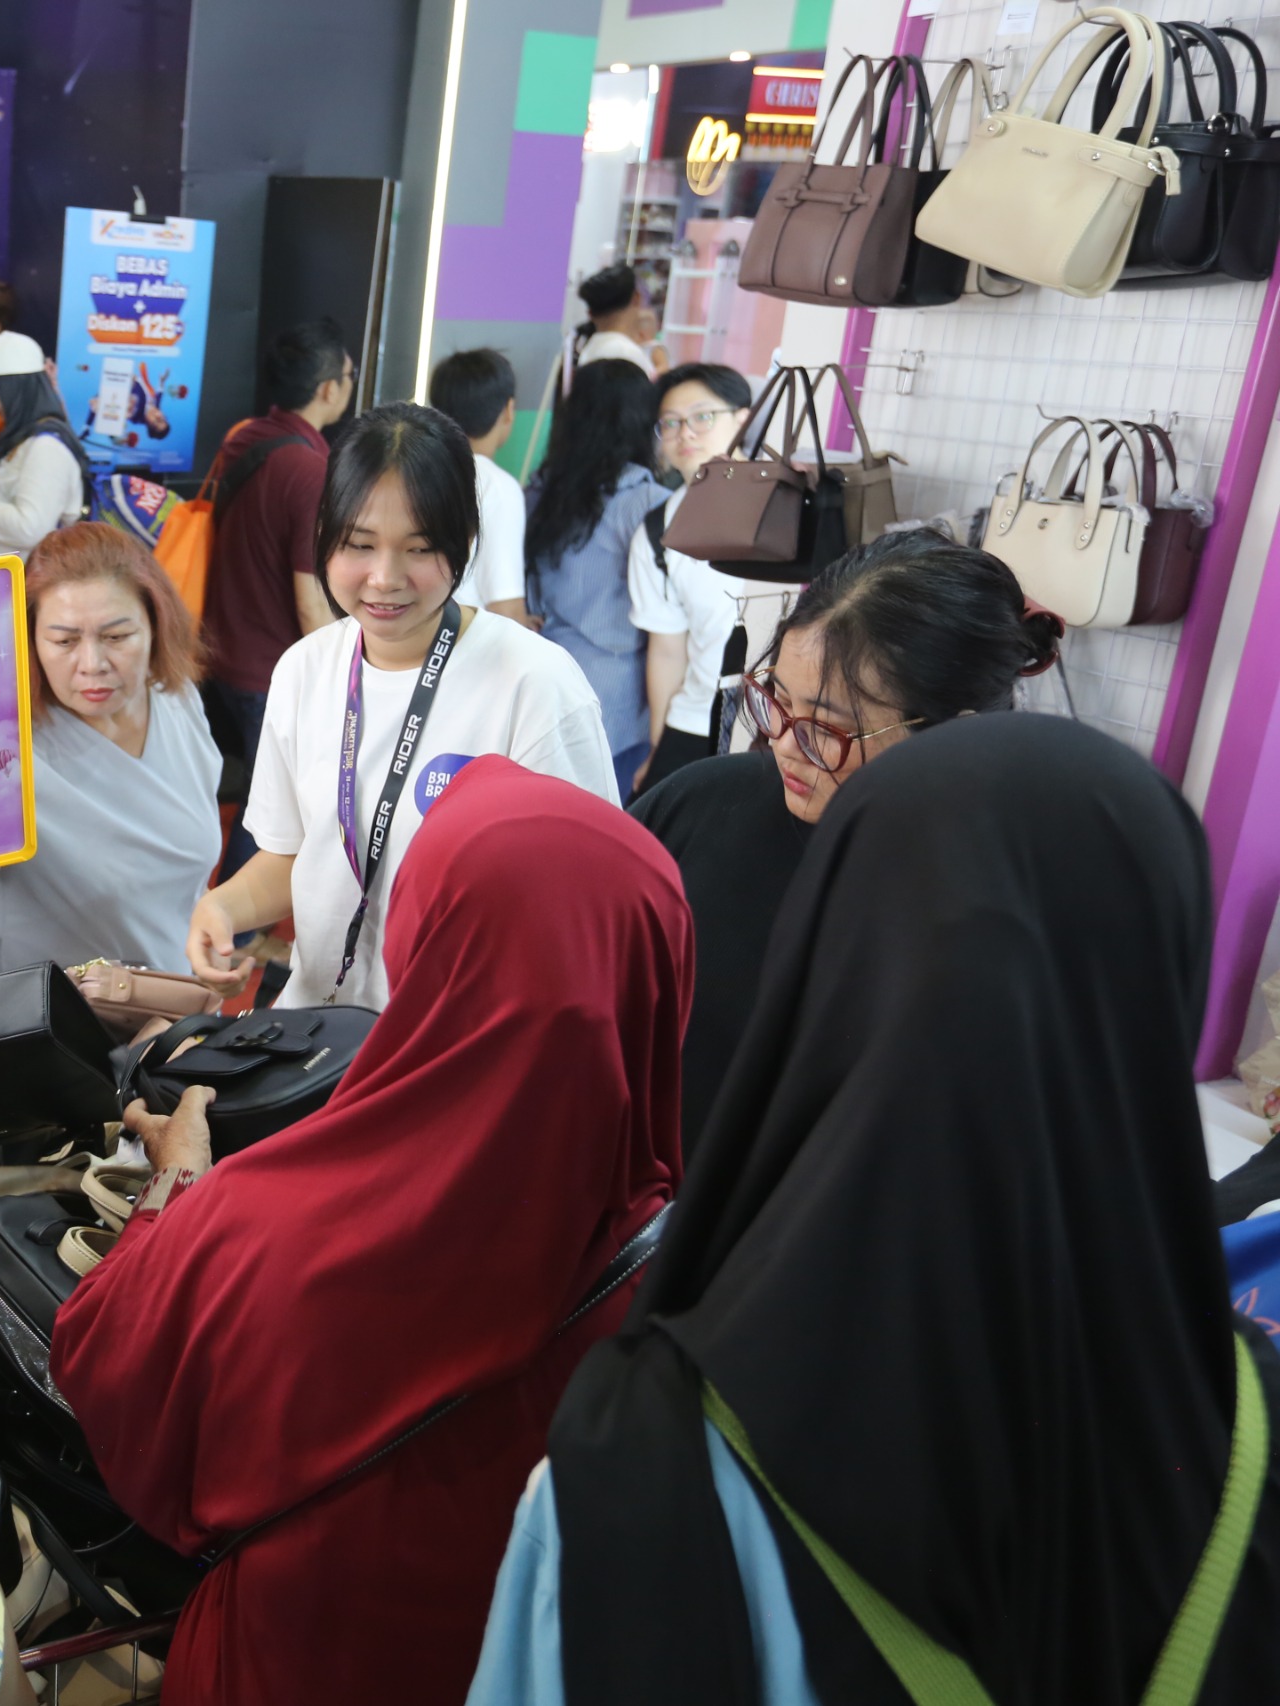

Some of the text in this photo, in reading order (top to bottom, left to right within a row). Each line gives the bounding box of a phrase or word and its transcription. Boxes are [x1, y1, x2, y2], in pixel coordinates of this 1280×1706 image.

[90, 276, 187, 299] Biaya Admin
[116, 255, 168, 276] BEBAS
[421, 628, 455, 688] RIDER
[347, 710, 358, 749] JAKARTA
[393, 714, 422, 775] RIDER
[371, 801, 393, 860] RIDER
